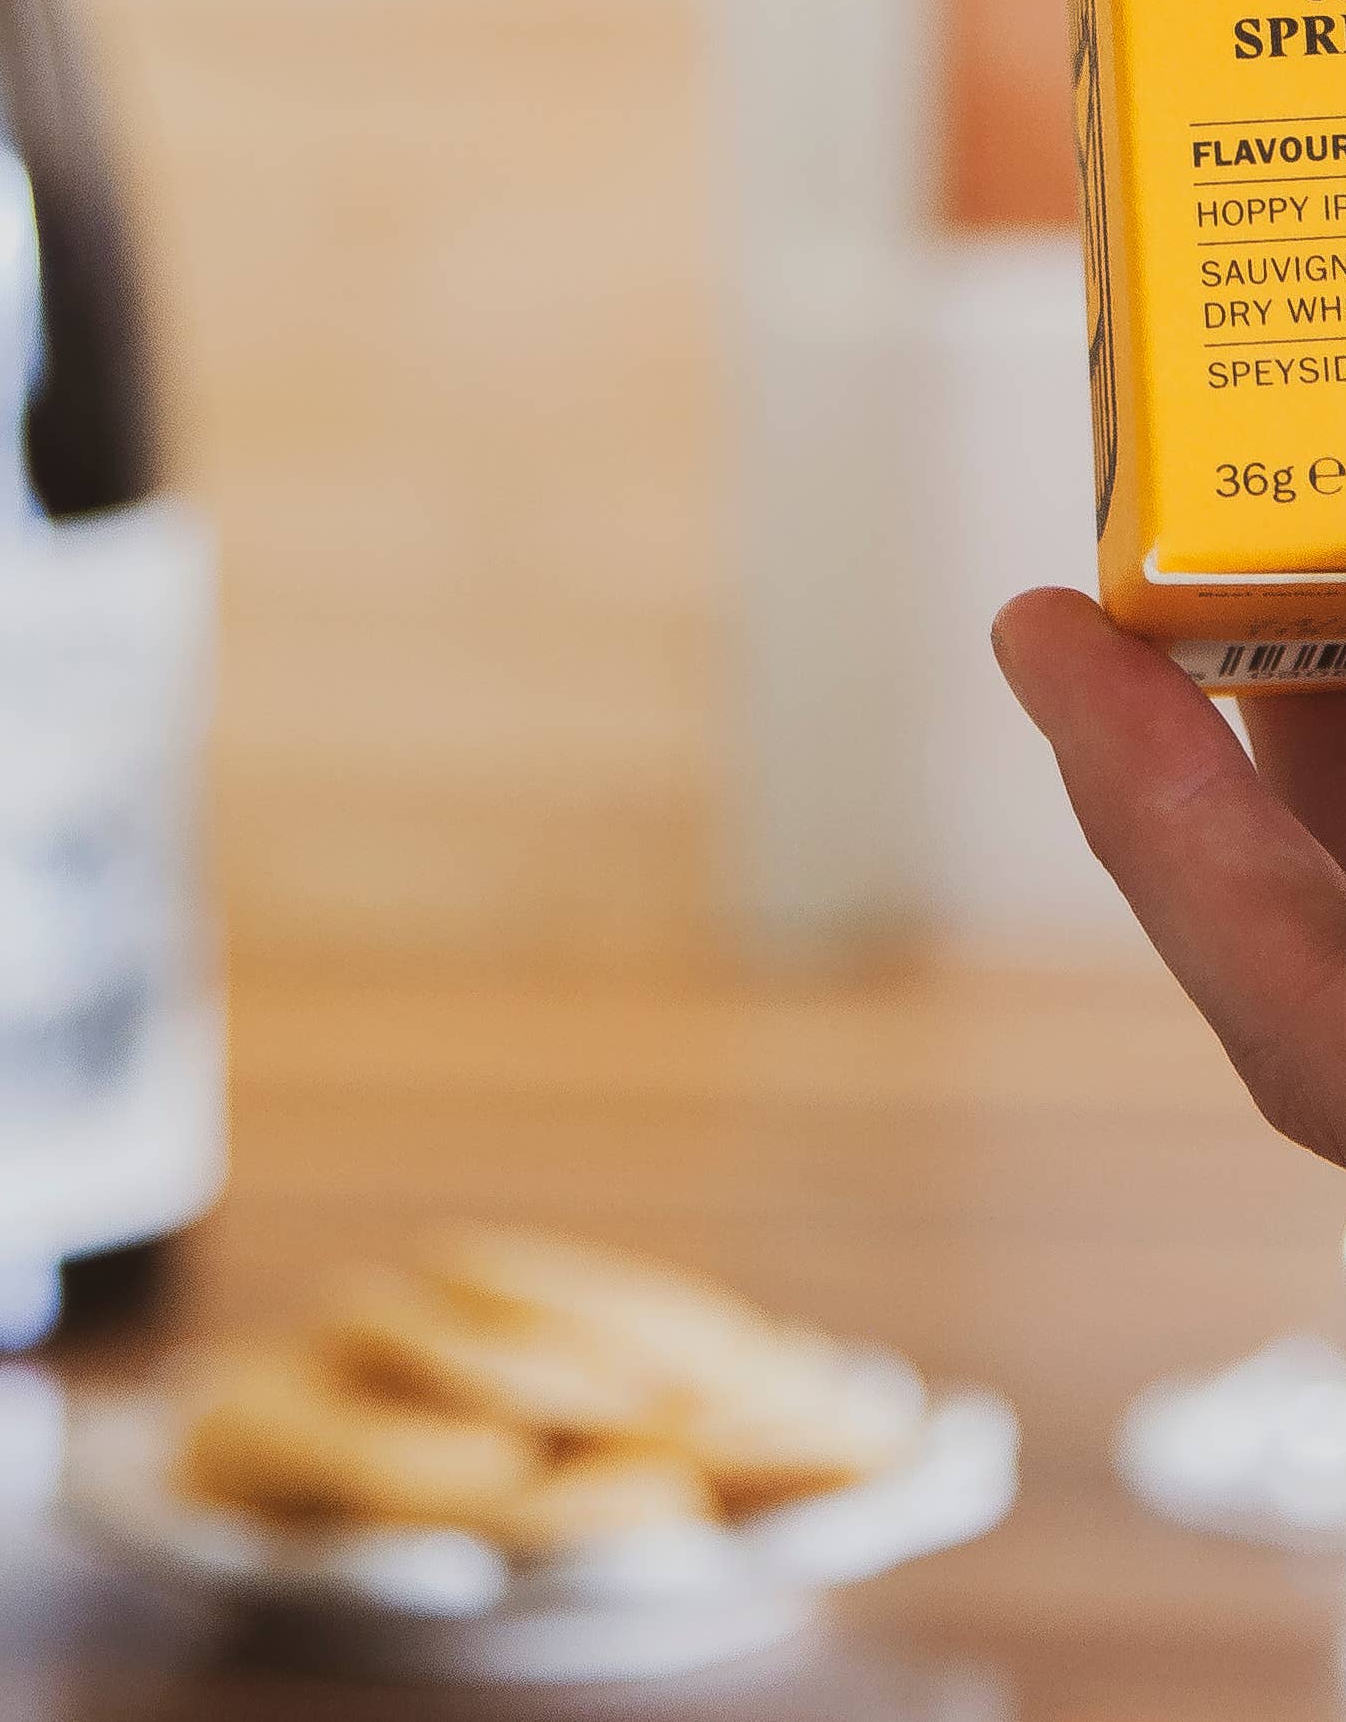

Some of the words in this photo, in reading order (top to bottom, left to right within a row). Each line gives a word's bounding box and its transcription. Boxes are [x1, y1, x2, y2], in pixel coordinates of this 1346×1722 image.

[1198, 196, 1308, 227] HOPPY
[1205, 299, 1272, 329] DRY
[1216, 462, 1296, 503] 36g
